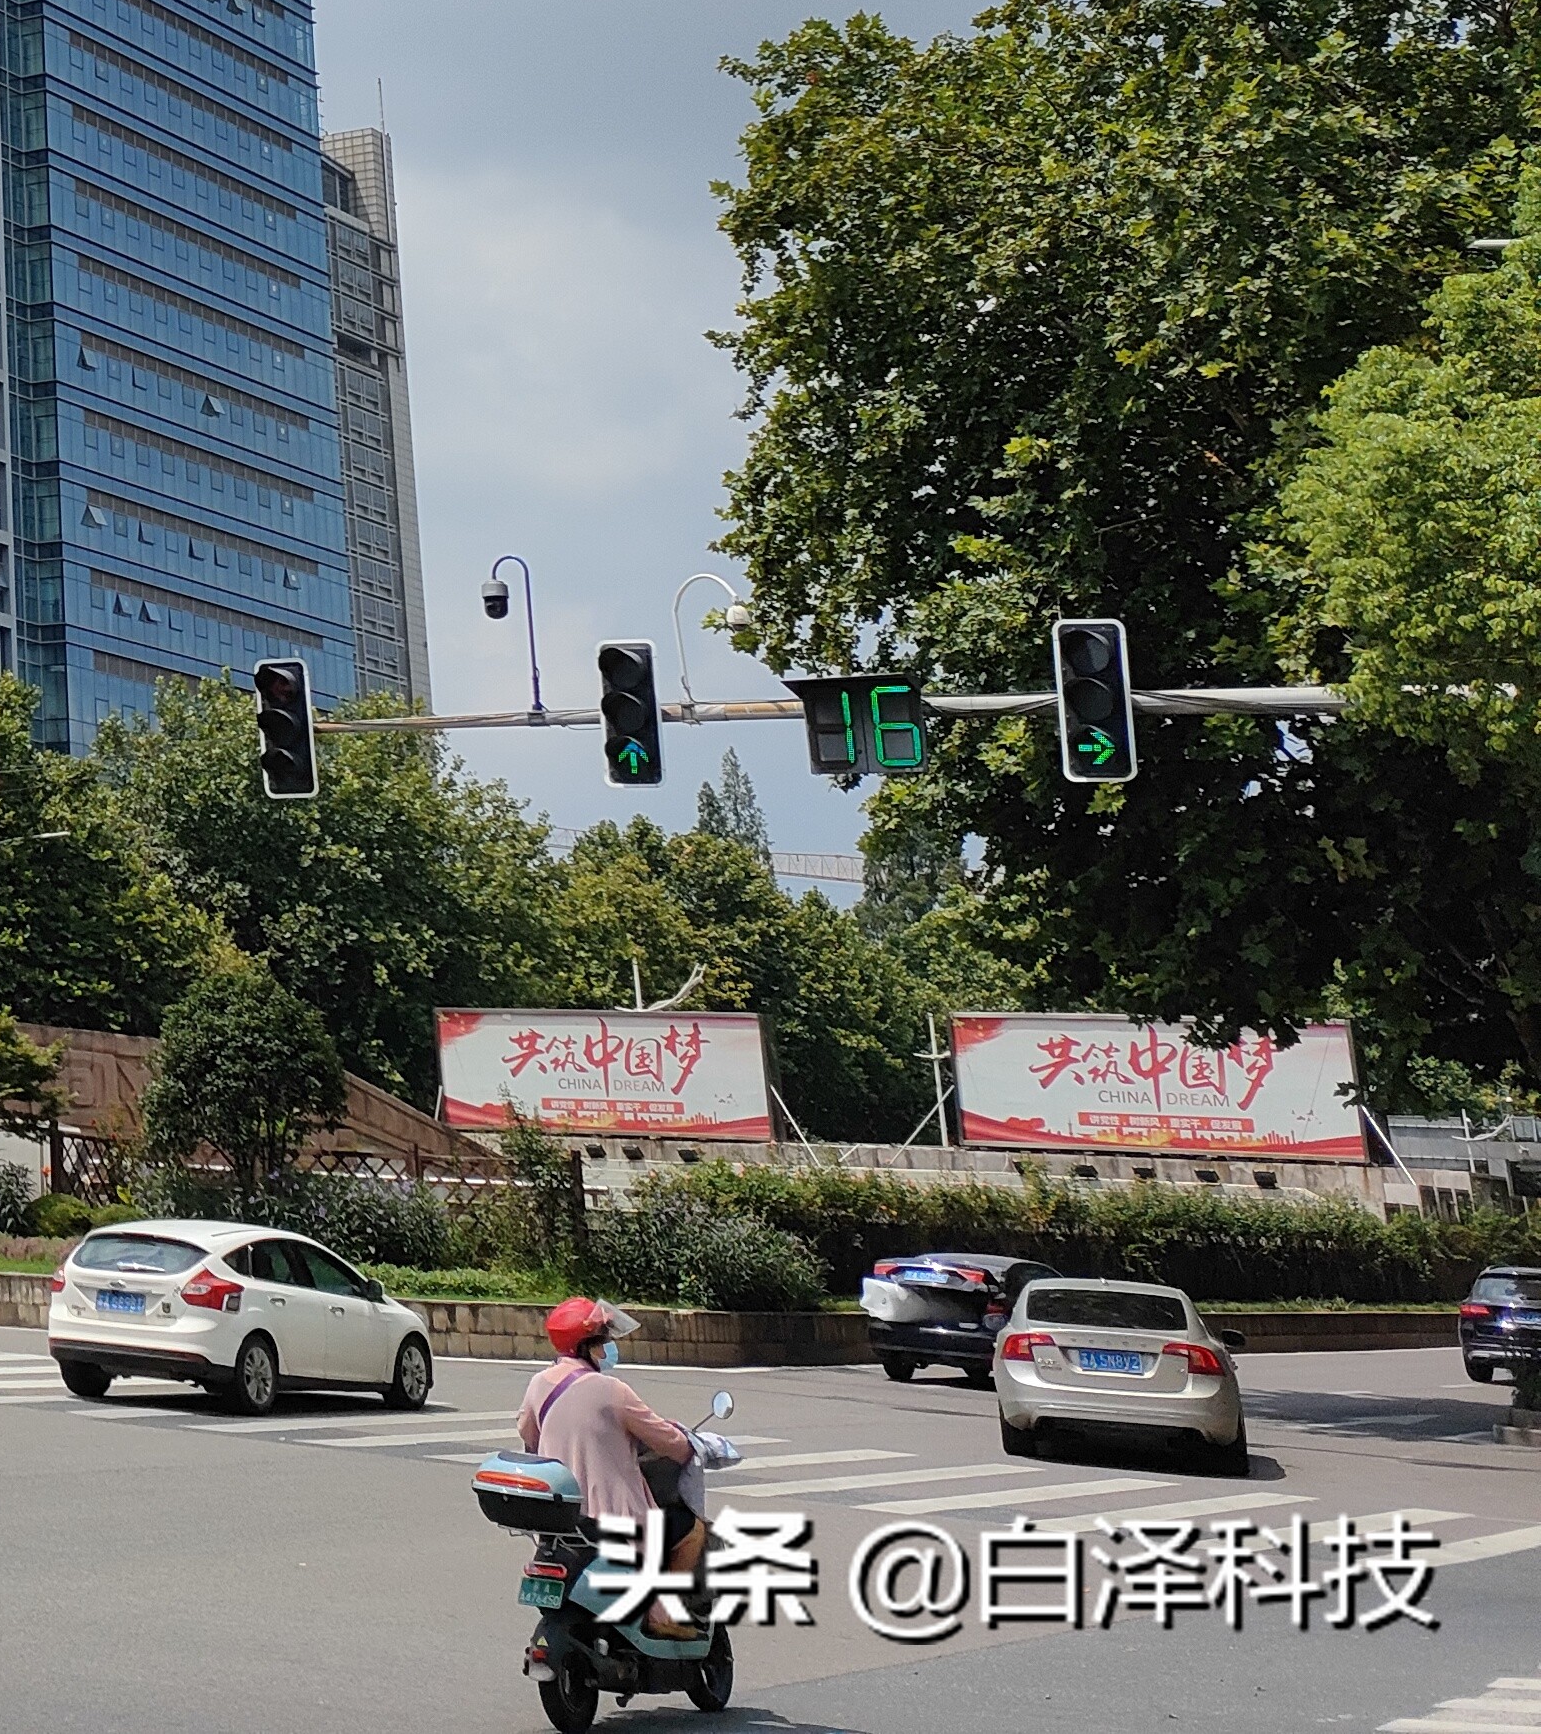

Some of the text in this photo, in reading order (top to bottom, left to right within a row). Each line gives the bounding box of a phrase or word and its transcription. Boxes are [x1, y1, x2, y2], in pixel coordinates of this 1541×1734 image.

[841, 685, 922, 766] 16
[501, 1016, 711, 1098] 共筑中国梦
[558, 1077, 666, 1093] CHINA DREAM
[1028, 1023, 1278, 1112] 共筑中国梦
[1098, 1090, 1231, 1108] CHINA DREAM
